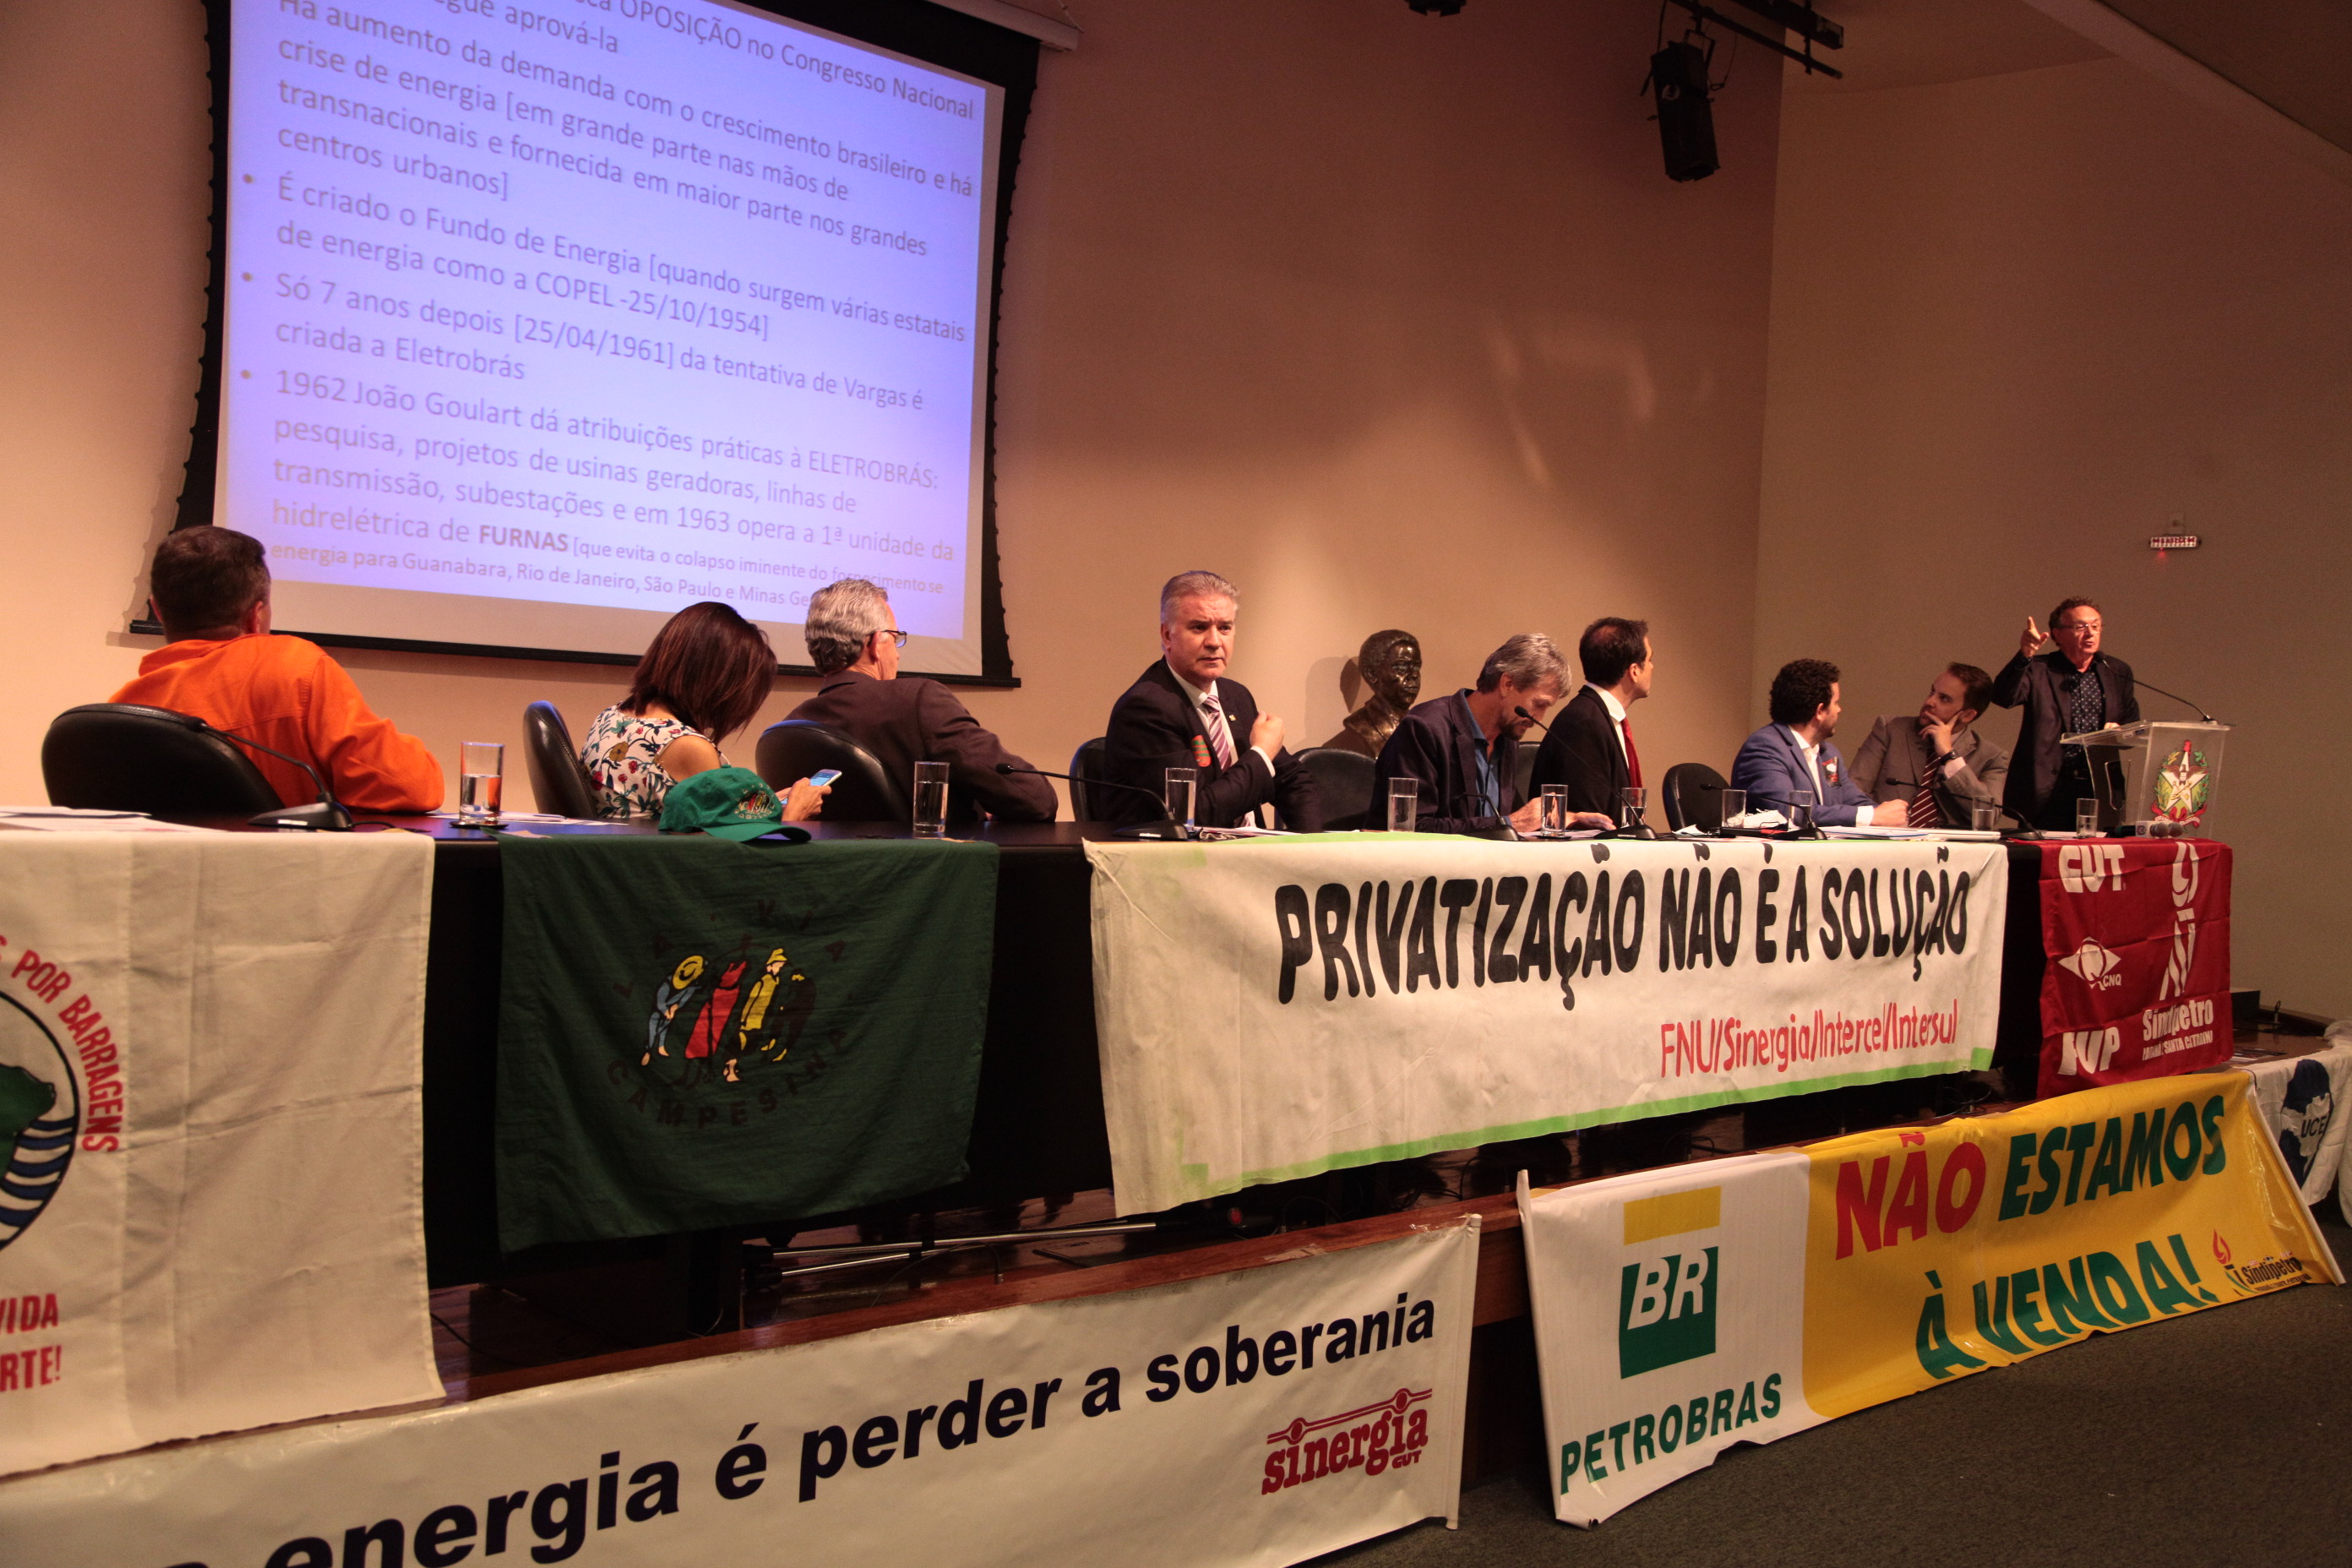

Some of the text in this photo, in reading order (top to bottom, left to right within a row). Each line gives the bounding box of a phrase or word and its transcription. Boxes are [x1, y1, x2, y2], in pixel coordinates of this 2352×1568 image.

[505, 6, 618, 53] aprová-la
[621, 0, 974, 120] OPOSIÇÃO no Congresso Nacional
[279, 39, 848, 201] crise de energia [em grande parte nas mãos de
[327, 7, 450, 56] aumento
[462, 40, 491, 68] da
[501, 51, 615, 101] demanda
[624, 90, 672, 117] com
[680, 104, 694, 122] o
[702, 108, 830, 158] crescimento
[839, 141, 926, 184] brasileiro
[934, 172, 945, 189] e
[950, 174, 972, 197] há
[278, 128, 508, 201] centros urbanos]
[278, 80, 928, 256] transnacionais e fornecida em maior parte nos grandes
[277, 220, 313, 248] de
[322, 231, 423, 271] energia
[433, 255, 505, 286] como
[514, 272, 528, 291] a
[278, 171, 966, 342] É criado o Fundo de Energia [quando surgem várias estatais
[275, 322, 525, 380] criada a Eletrobrás
[276, 273, 923, 411] Só 7 anos depois [25/04/1961] da tentativa de Vargas é
[275, 420, 857, 513] pesquisa, projetos de usinas geradoras, linhas de
[277, 369, 939, 490] 1962 João Goulart dá atribuições práticas à ELETROBRÁS:
[273, 499, 429, 539] hidrelétrica
[439, 517, 470, 542] de
[479, 525, 569, 553] FURNAS
[573, 536, 612, 558] [que
[616, 544, 655, 562] evita
[661, 551, 671, 564] o
[675, 550, 735, 571] colapso
[739, 556, 805, 578] iminente
[809, 564, 827, 580] do
[929, 581, 943, 593] se
[274, 460, 445, 504] transmissão,
[455, 480, 603, 519] subestações
[612, 502, 626, 520] e
[634, 506, 668, 525] em
[677, 506, 730, 533] 1963
[738, 519, 795, 542] opera
[803, 528, 814, 543] a
[848, 531, 925, 558] unidade
[932, 538, 954, 561] da
[271, 544, 348, 567] energia
[353, 552, 397, 569] para
[403, 553, 512, 582] Guanabara,
[517, 564, 543, 581] Rio
[549, 568, 570, 585] de
[574, 569, 640, 594] Janeiro,
[645, 575, 672, 593] São
[678, 579, 721, 598] Paulo
[726, 587, 735, 599] e
[740, 585, 784, 604] Minas
[2059, 845, 2125, 893] CUT
[1275, 843, 1646, 1011] PRIVATIZAÇÃO
[1659, 842, 1742, 972] NÃO
[1786, 864, 1809, 963] A
[1819, 846, 1970, 983] SOLUÇÃO
[2103, 973, 2122, 988] CNQ
[11, 950, 123, 1154] POR BARRAGENS
[1836, 1095, 2226, 1260] NÃO ESTAMOS
[1628, 1250, 1709, 1330] BR
[1915, 1233, 2221, 1380] À VENDA!
[715, 1423, 768, 1500] é
[798, 1379, 1063, 1503] perder
[1081, 1366, 1122, 1418] a
[1146, 1292, 1435, 1402] soberania
[1261, 1402, 1428, 1497] sinergia
[1560, 1373, 1783, 1495] PETROBRAS
[1391, 1449, 1422, 1469] CUT
